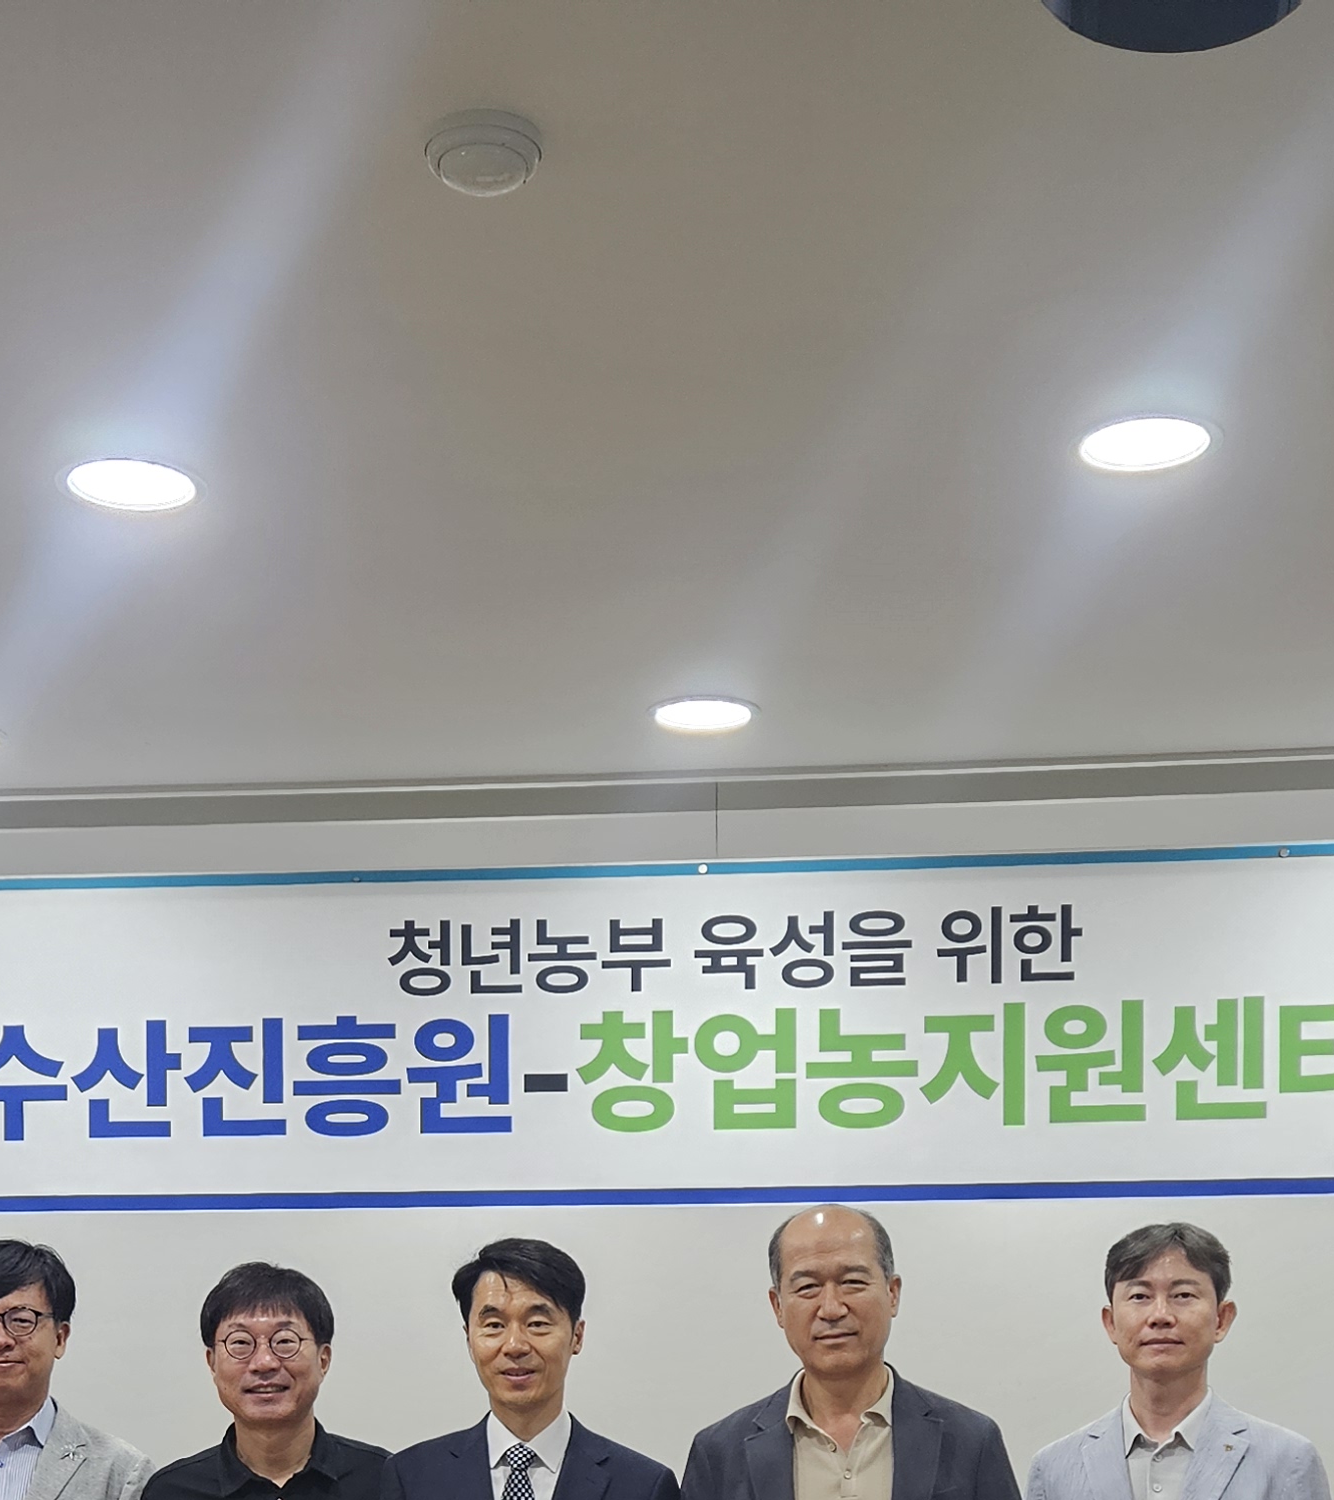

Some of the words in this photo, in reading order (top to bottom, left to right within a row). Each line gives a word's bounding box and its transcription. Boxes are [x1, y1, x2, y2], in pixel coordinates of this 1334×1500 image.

[388, 917, 672, 997] 청년농부
[693, 910, 913, 990] 육성을
[936, 903, 1083, 985] 위한
